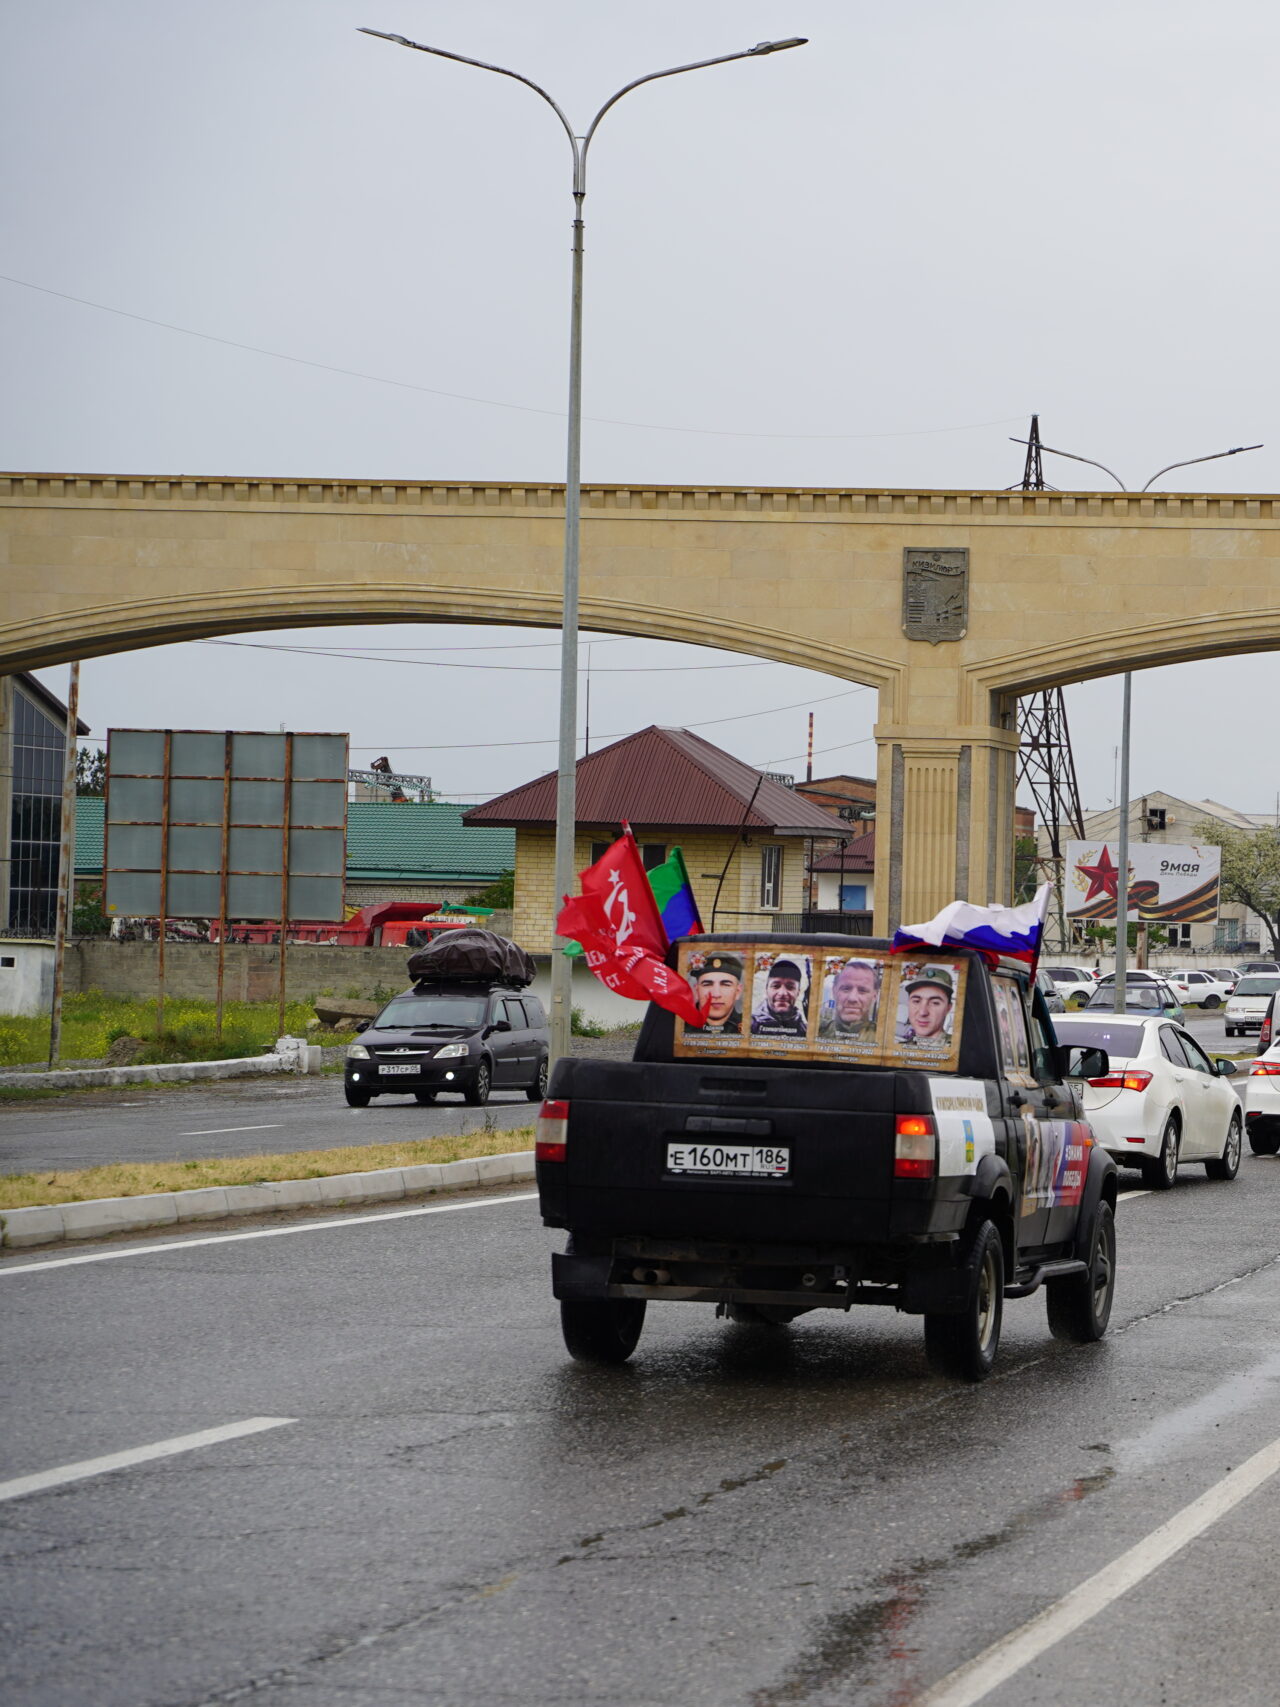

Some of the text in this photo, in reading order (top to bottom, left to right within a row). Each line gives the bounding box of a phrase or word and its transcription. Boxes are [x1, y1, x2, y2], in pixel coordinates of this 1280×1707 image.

[912, 560, 960, 574] КИЗИЛЮРТ
[673, 1147, 784, 1168] Е160МТ 186
